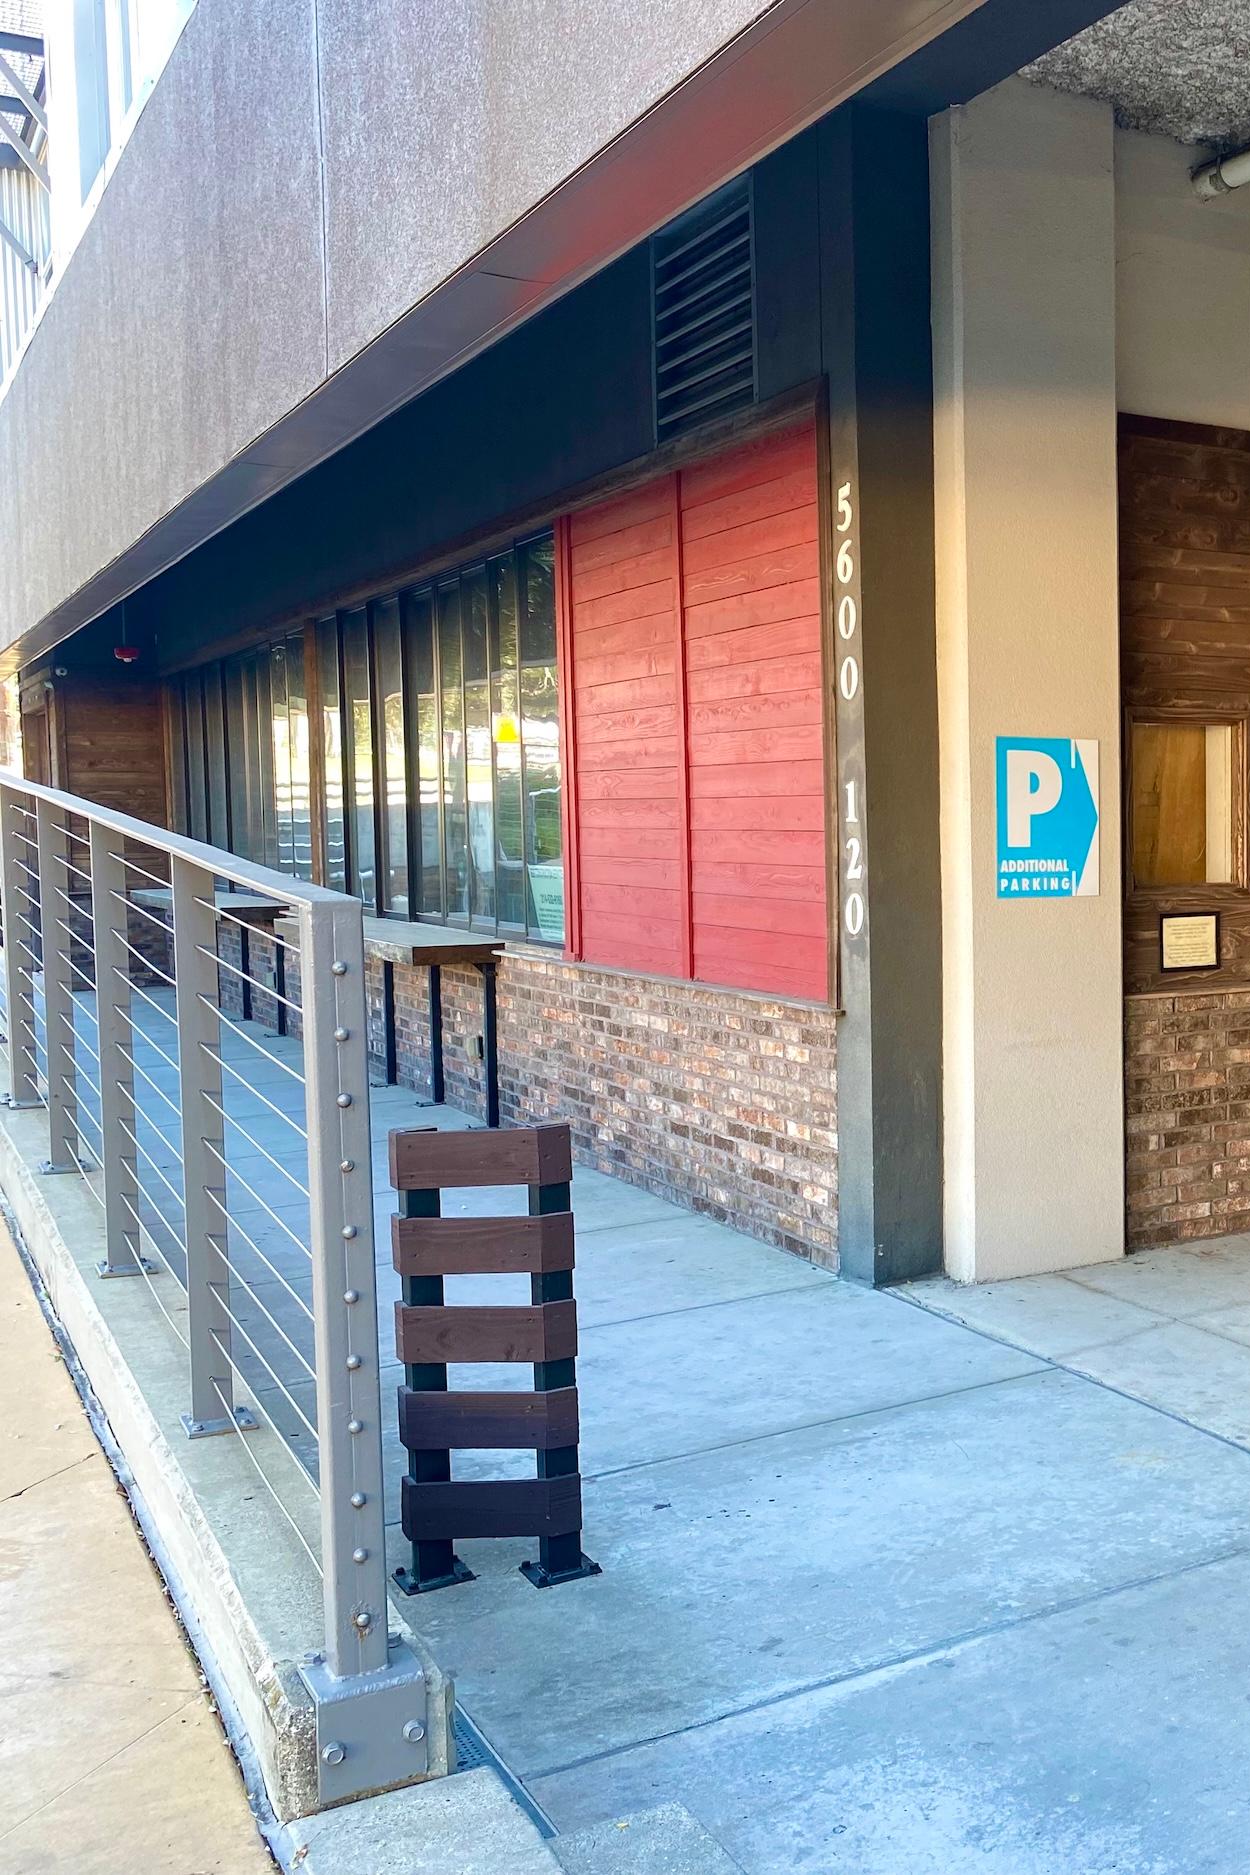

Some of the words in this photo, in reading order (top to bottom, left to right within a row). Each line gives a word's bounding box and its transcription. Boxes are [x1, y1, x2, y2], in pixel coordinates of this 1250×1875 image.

[836, 482, 859, 700] 5600
[1006, 749, 1063, 848] P
[845, 781, 863, 936] 120
[1000, 858, 1070, 873] ADDITIONAL
[1000, 877, 1071, 892] PARKING
